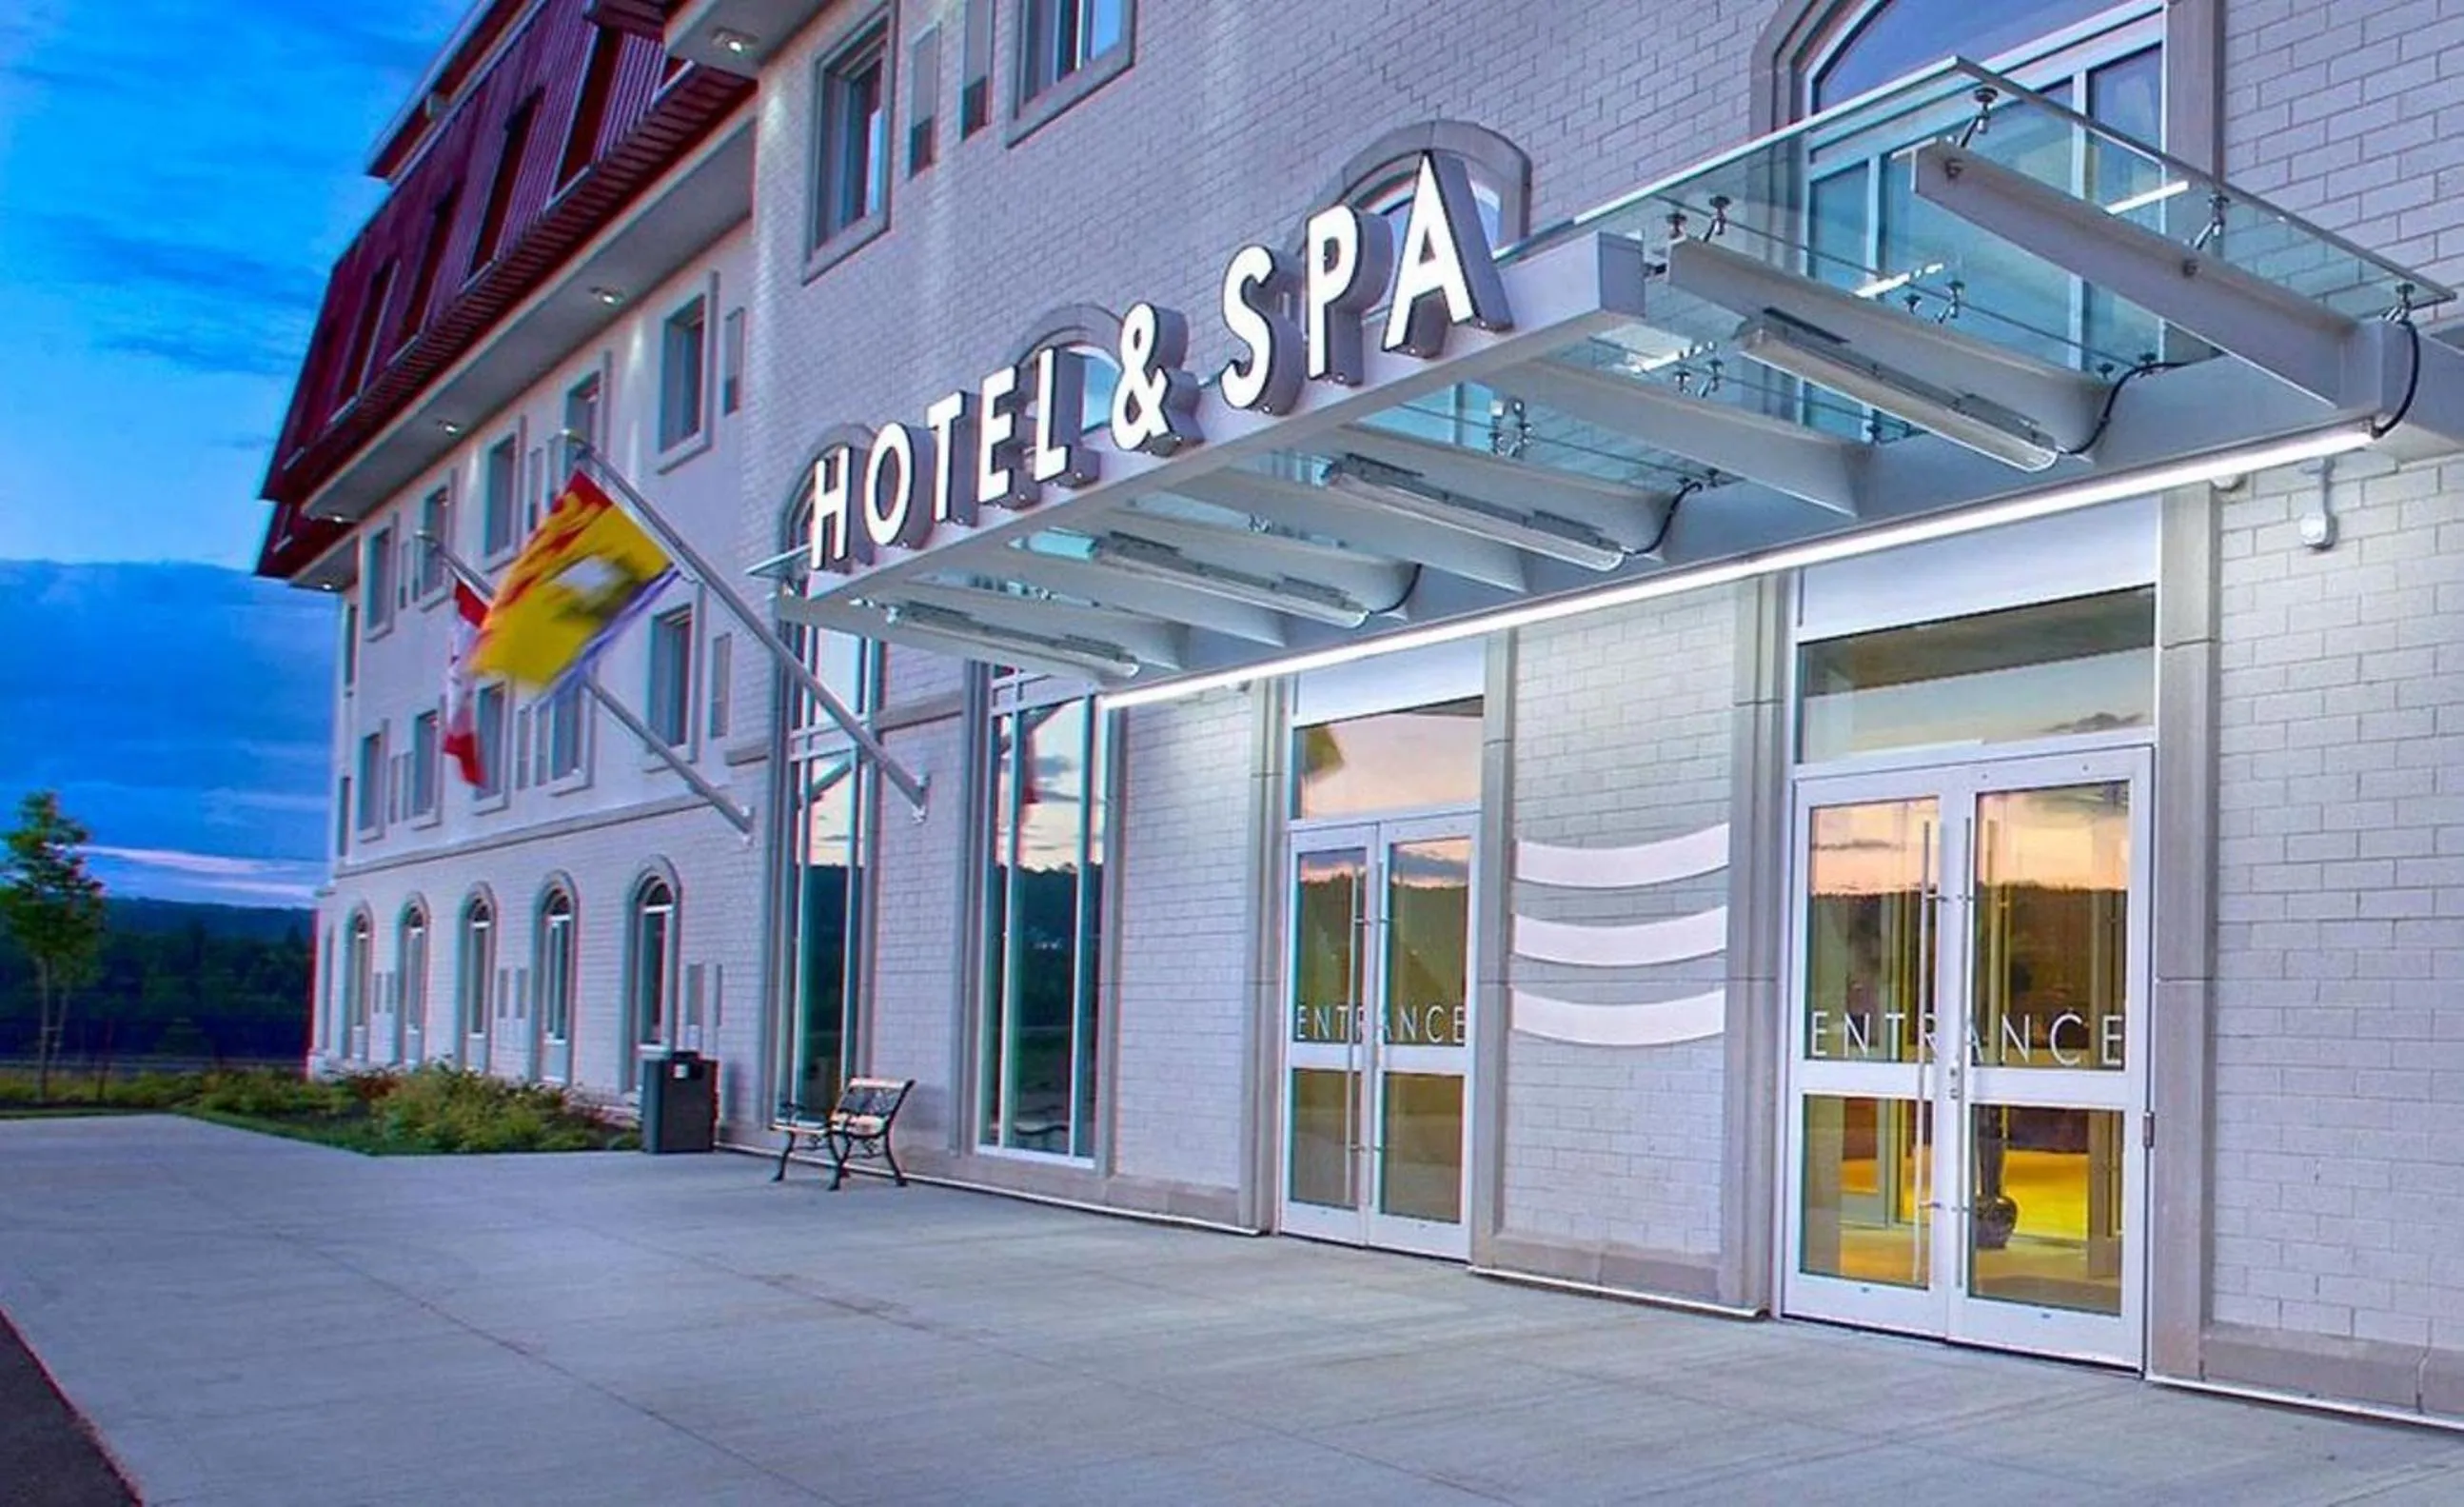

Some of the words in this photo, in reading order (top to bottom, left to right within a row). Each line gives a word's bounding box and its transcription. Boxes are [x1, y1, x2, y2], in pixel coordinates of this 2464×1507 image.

[810, 347, 1074, 570] HOTEL
[1112, 302, 1171, 452] &
[1220, 152, 1475, 410] SPA
[1811, 1011, 2124, 1065] ENTRANCE
